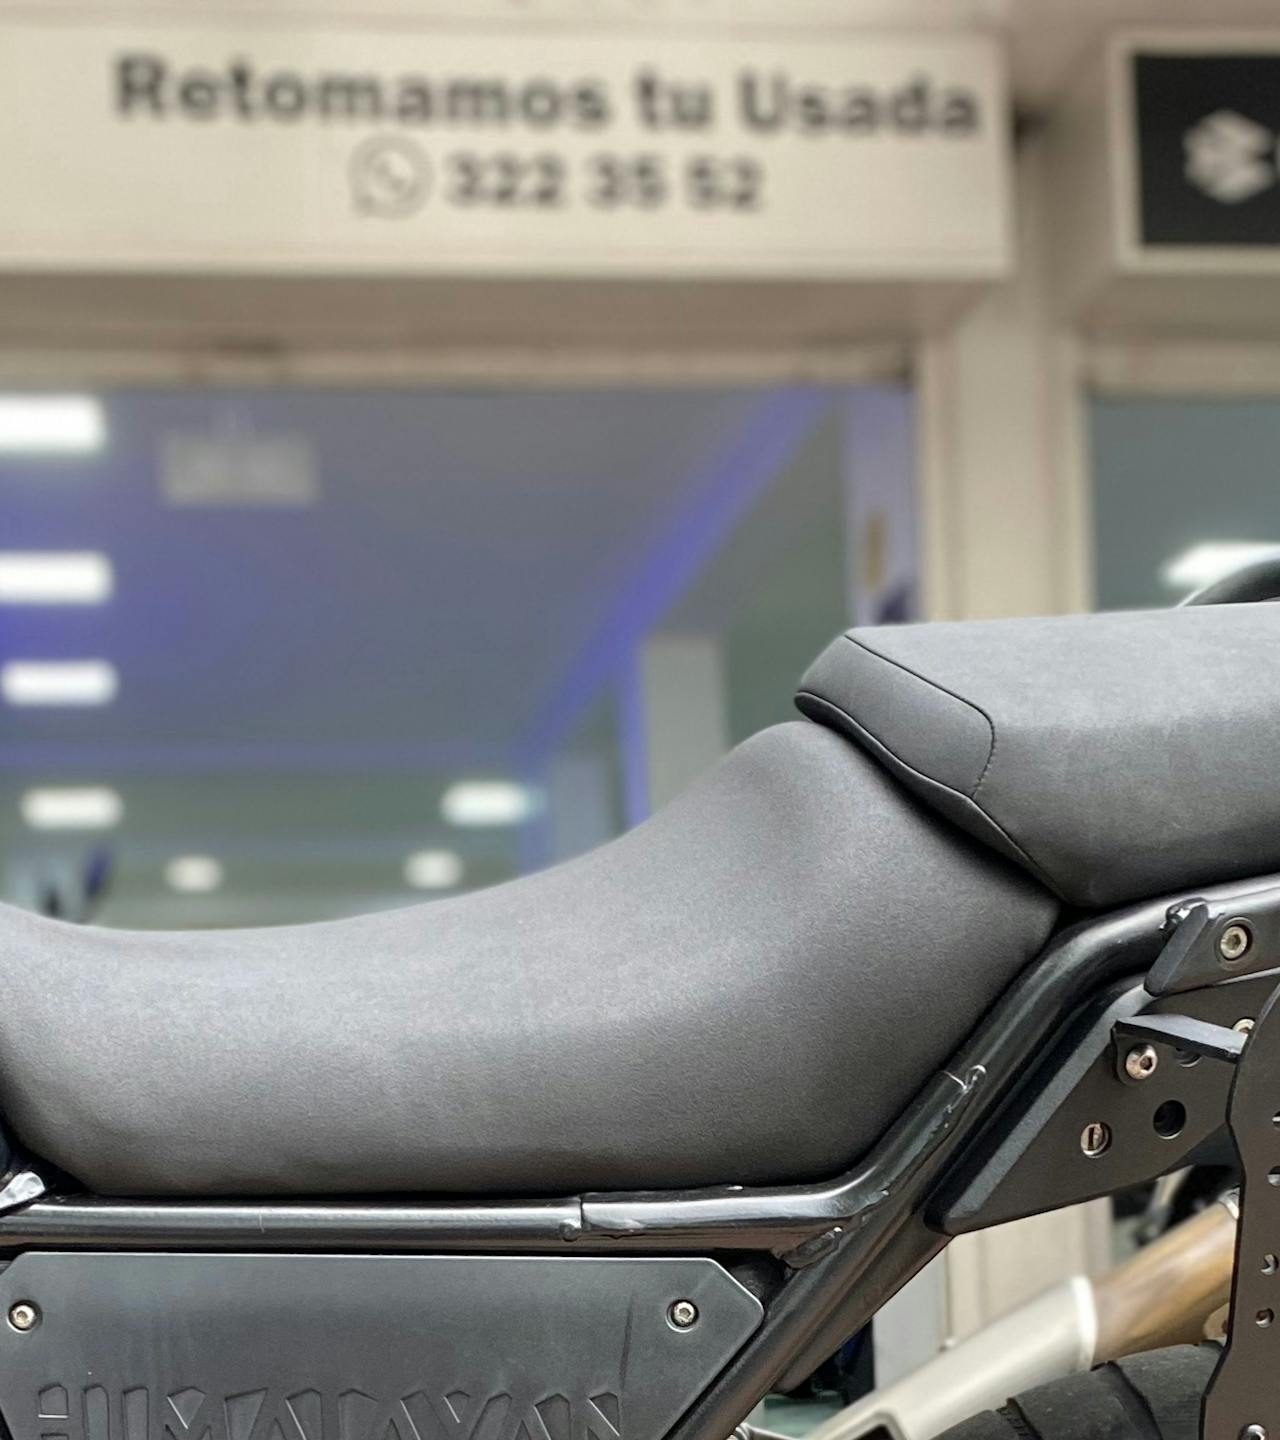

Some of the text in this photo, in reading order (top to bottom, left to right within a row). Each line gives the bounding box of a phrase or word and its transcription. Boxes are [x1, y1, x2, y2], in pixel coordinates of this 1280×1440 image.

[114, 54, 982, 135] Retomamos tu Usada
